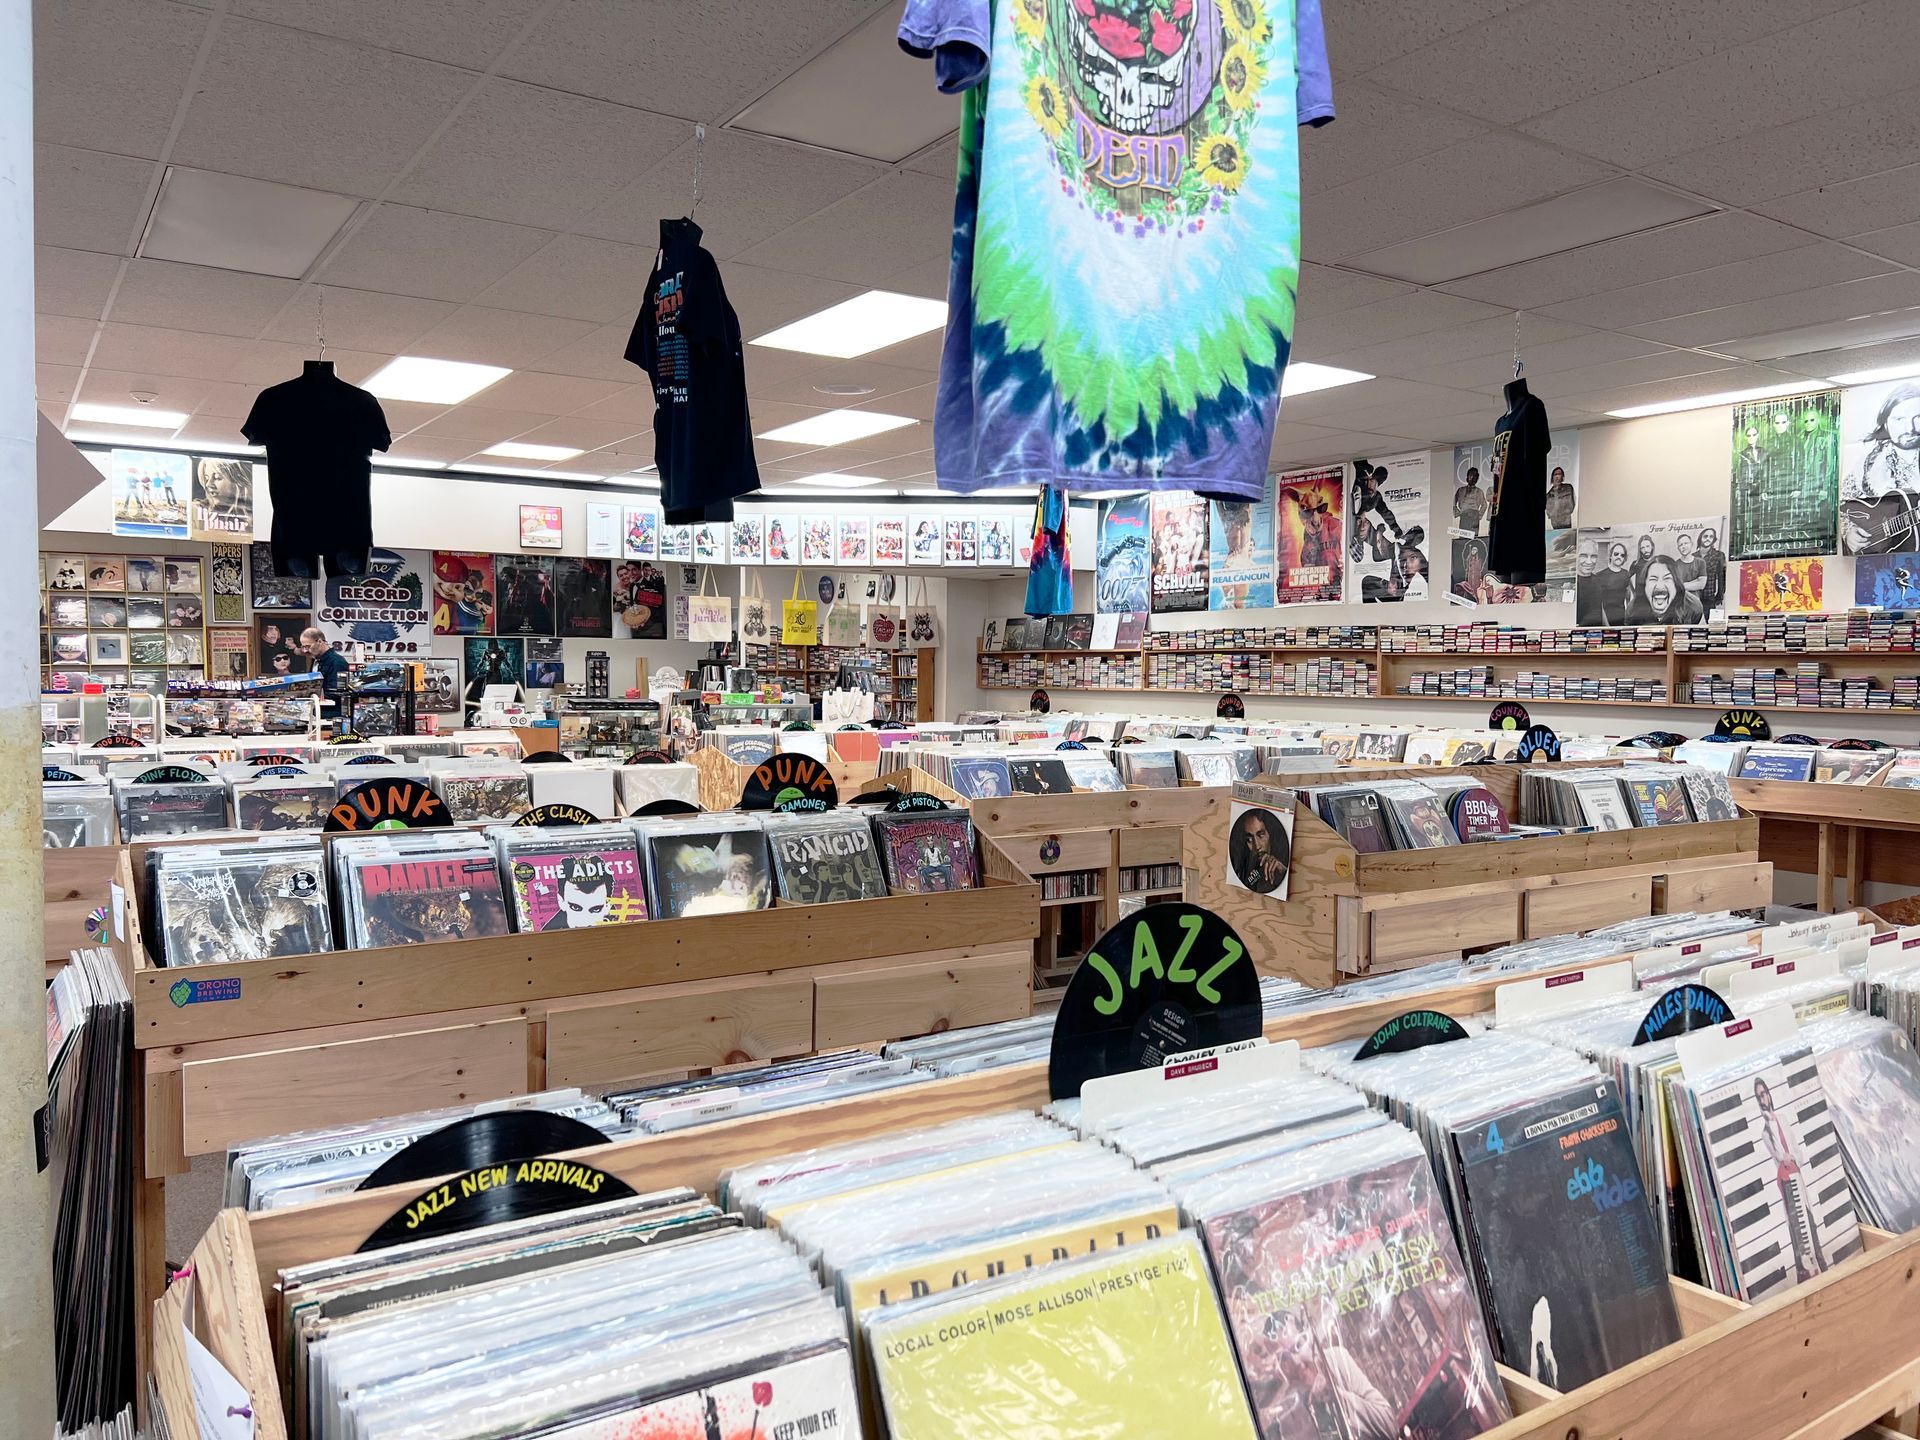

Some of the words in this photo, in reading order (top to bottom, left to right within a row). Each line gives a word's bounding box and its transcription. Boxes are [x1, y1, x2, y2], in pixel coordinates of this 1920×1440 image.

[1069, 99, 1187, 192] DEAD
[1384, 487, 1413, 496] STREET
[1390, 491, 1421, 501] FIGHTER
[1668, 522, 1705, 532] Fighters
[1752, 530, 1811, 542] MATRIX
[213, 546, 242, 558] PAPERS
[1742, 540, 1824, 553] RELOADED
[1153, 570, 1205, 590] SCHOOL
[1212, 575, 1233, 584] REAL
[1233, 571, 1270, 583] CANCUN
[1289, 573, 1331, 587] JACK
[340, 587, 410, 600] RECORD
[320, 607, 429, 622] CONNECTION
[433, 603, 451, 631] A
[1218, 697, 1243, 710] COUNTRY
[1490, 706, 1529, 721] COUNTRY
[1720, 711, 1764, 729] FUNK
[116, 736, 140, 748] DYLAN
[1519, 730, 1559, 758] BLUES
[47, 771, 74, 781] PETTY
[140, 769, 166, 784] PINK
[169, 768, 203, 783] FLOYD
[755, 758, 833, 793] PUNK
[1755, 765, 1793, 774] Supremes
[1237, 786, 1254, 795] BOB
[332, 784, 440, 831] PUNK
[781, 798, 827, 812] RAMONES
[897, 800, 911, 812] SEX
[912, 797, 941, 810] PISTOLS
[1465, 800, 1488, 815] BBQ
[518, 808, 545, 827] THE
[550, 805, 591, 825] CLASH
[1468, 815, 1488, 826] TIMER
[781, 831, 870, 863] RANCID
[361, 857, 498, 898] PANTERA
[534, 864, 565, 880] THE
[572, 860, 634, 878] ADICTS
[1087, 914, 1243, 1016] JAZZ
[197, 979, 240, 990] ORONO
[197, 988, 239, 997] BREWING
[1818, 999, 1847, 1011] FREEMAN
[1163, 1008, 1185, 1026] DESIGN
[1644, 991, 1682, 1041] MILES
[1687, 988, 1724, 1023] DAVIS
[1372, 1019, 1400, 1050] JOHN
[1403, 1012, 1452, 1034] COLTRANE
[1170, 1067, 1185, 1076] DAVE
[1548, 1118, 1558, 1131] PAK
[1558, 1115, 1569, 1127] TWO
[1569, 1109, 1588, 1124] RECORD
[1588, 1104, 1598, 1116] SET
[1486, 1120, 1505, 1154] 4
[1558, 1132, 1581, 1149] FRANK
[1580, 1118, 1618, 1142] CHACKSFIELD
[1563, 1151, 1576, 1161] PLAYS
[1567, 1157, 1604, 1201] ebb
[405, 1189, 457, 1230] JAZZ
[462, 1165, 509, 1198] NEW
[515, 1160, 605, 1195] ARRIVALS
[886, 1333, 934, 1360] LOCAL
[938, 1317, 987, 1344] COLOR
[994, 1303, 1035, 1327] MOSE
[1038, 1286, 1093, 1314] ALLISON
[1099, 1265, 1162, 1295] PRESTIGE
[773, 1422, 795, 1440] KEEP
[796, 1415, 821, 1438] YOUR
[822, 1408, 839, 1429] EYE
